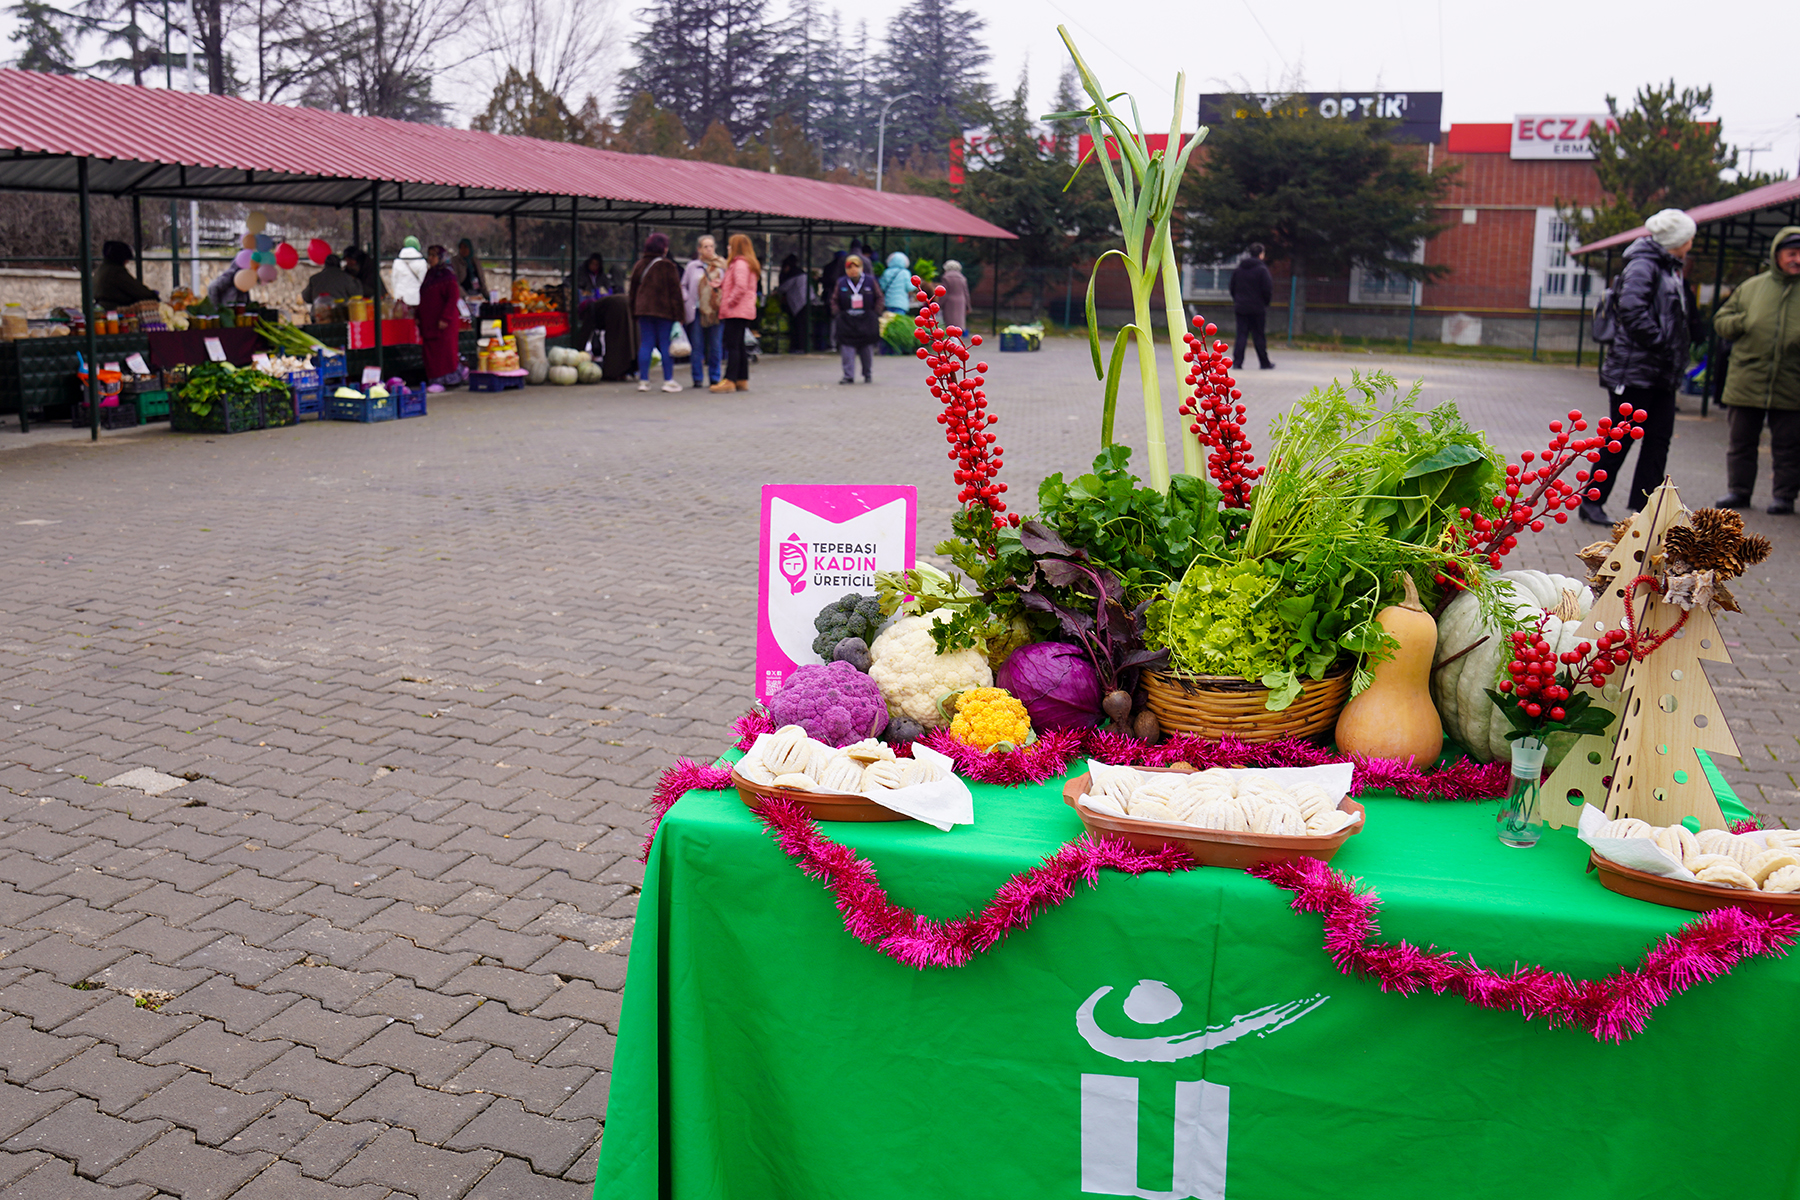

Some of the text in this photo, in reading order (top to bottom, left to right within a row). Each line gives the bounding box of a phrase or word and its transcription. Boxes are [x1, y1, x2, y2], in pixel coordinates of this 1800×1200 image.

[1319, 93, 1403, 119] OPTİK
[812, 543, 876, 554] TEPEBAŞI
[814, 556, 876, 571] KADIN
